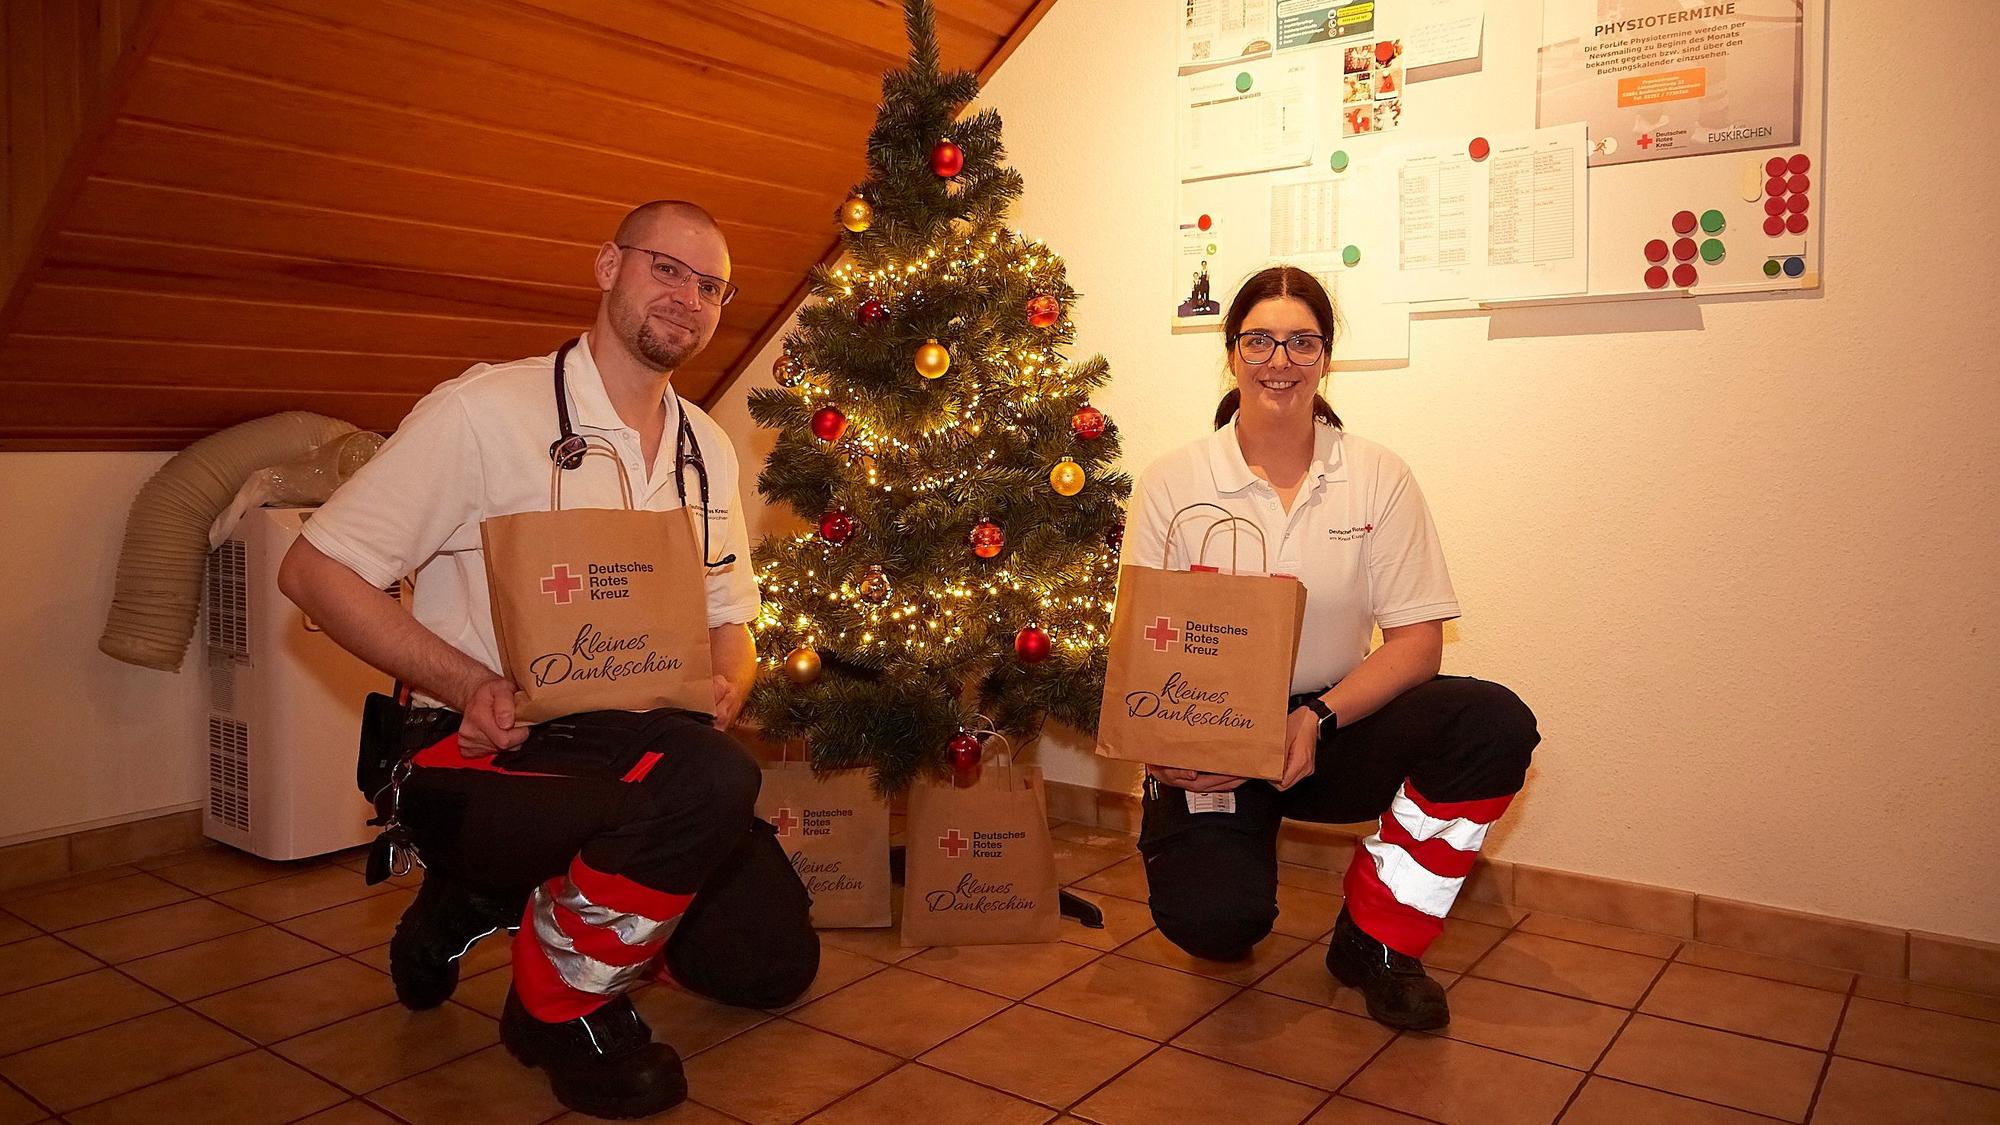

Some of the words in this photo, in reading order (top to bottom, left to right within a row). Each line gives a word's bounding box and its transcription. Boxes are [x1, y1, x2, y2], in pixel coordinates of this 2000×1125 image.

[1594, 2, 1736, 36] PHYSIOTERMINE
[1584, 44, 1598, 53] Die
[1599, 39, 1628, 50] ForLife
[1630, 30, 1692, 45] Physiotermine
[1695, 24, 1728, 35] werden
[1730, 21, 1746, 30] per
[1589, 45, 1642, 60] Newsmailing
[1644, 43, 1654, 51] zu
[1657, 39, 1687, 51] Beginn
[1689, 35, 1705, 44] des
[1707, 30, 1740, 41] Monats
[1585, 57, 1619, 69] bekannt
[1621, 51, 1657, 65] gegeben
[1659, 48, 1680, 57] bzw.
[1682, 45, 1700, 54] sind
[1703, 40, 1724, 51] über
[1726, 38, 1743, 47] den
[1597, 57, 1674, 75] Buchungskalender
[1676, 49, 1730, 63] einzusehen.
[1655, 129, 1687, 137] Deutsches
[1708, 126, 1773, 143] EUSKIRCHEN
[588, 561, 654, 574] Deutsches
[589, 575, 628, 588] Rotes
[590, 588, 630, 601] Kreuz
[1185, 621, 1248, 636] Deutsches
[572, 623, 649, 660] kleines
[1184, 632, 1219, 645] Rotes
[1184, 643, 1219, 656] Kreuz
[530, 651, 683, 688] Dankeschön
[1161, 672, 1229, 704] kleines
[1125, 691, 1255, 730] Dankeschön
[803, 809, 853, 818] Deutsches
[803, 818, 831, 827] Rotes
[803, 827, 831, 836] Kreuz
[973, 831, 1026, 840] Deutsches
[973, 840, 1003, 849] Rotes
[973, 849, 1003, 858] Kreuz
[806, 874, 865, 895] keschön
[956, 872, 1014, 899] kleines
[925, 890, 1036, 914] Dankeschön
